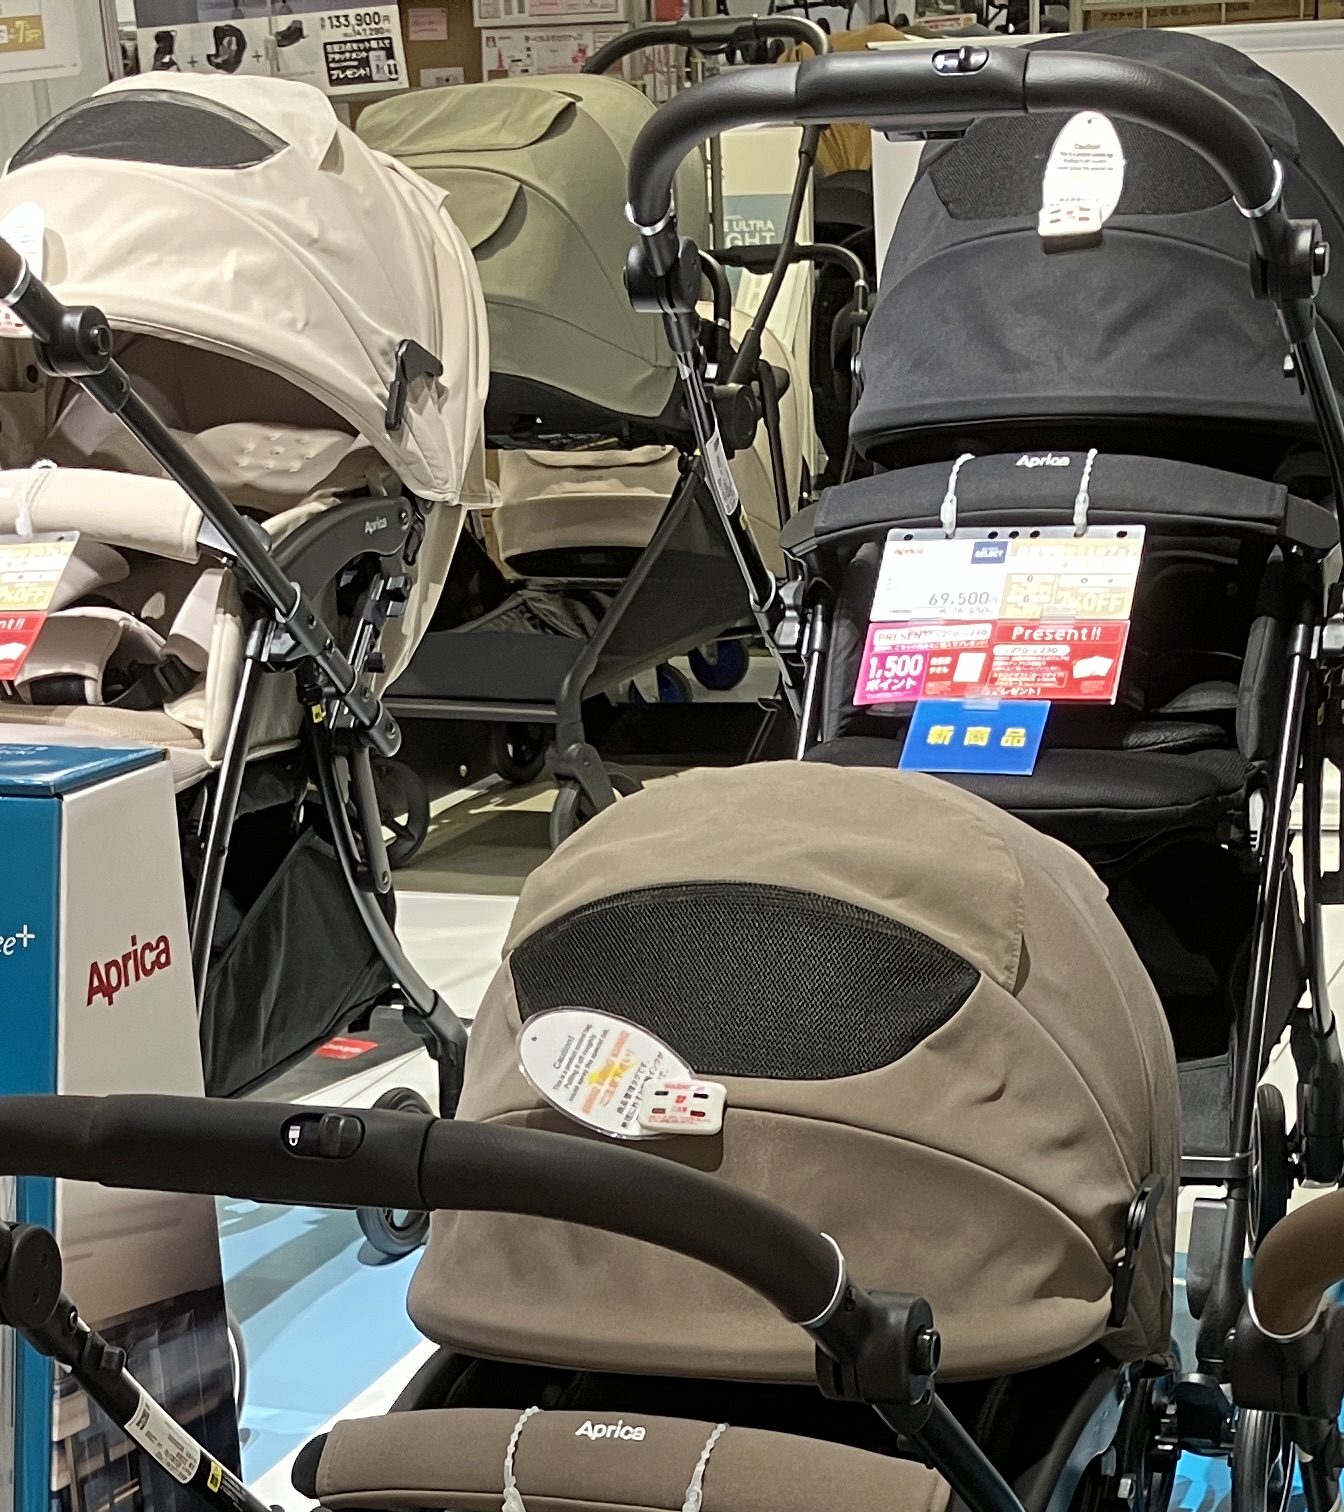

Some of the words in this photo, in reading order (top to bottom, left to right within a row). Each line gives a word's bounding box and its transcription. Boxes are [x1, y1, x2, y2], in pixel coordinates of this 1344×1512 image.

[732, 220, 776, 231] ULTRA
[1016, 454, 1070, 468] Aprica
[1011, 626, 1102, 641] Present!!
[869, 654, 924, 679] 1,500
[865, 677, 917, 692] ポイント
[926, 725, 1027, 748] 新商品
[86, 934, 172, 1008] Aprica
[550, 1034, 576, 1070] Caution!
[575, 1419, 647, 1442] Aprica
